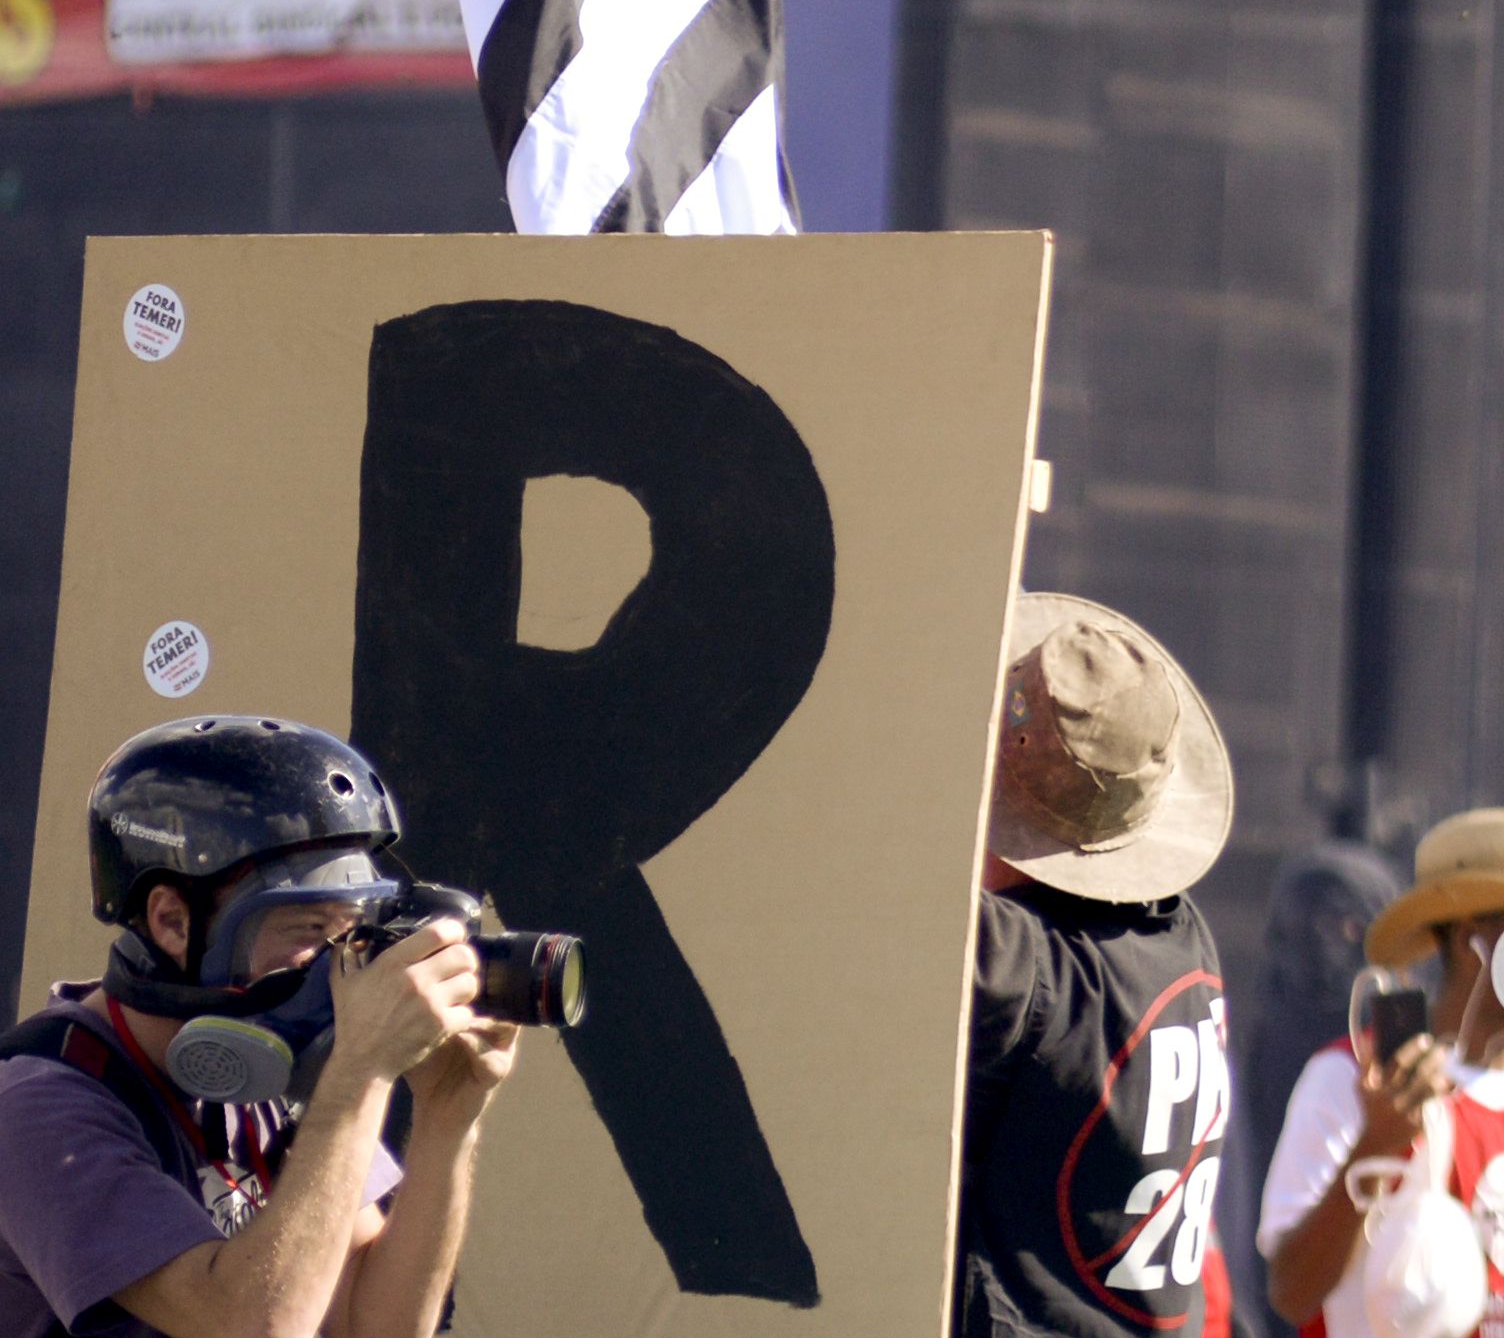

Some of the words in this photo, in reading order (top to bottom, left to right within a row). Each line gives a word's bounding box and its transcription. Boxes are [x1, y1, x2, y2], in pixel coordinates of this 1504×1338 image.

[146, 290, 176, 314] FORA
[150, 626, 183, 655] FORA
[350, 297, 837, 1333] R
